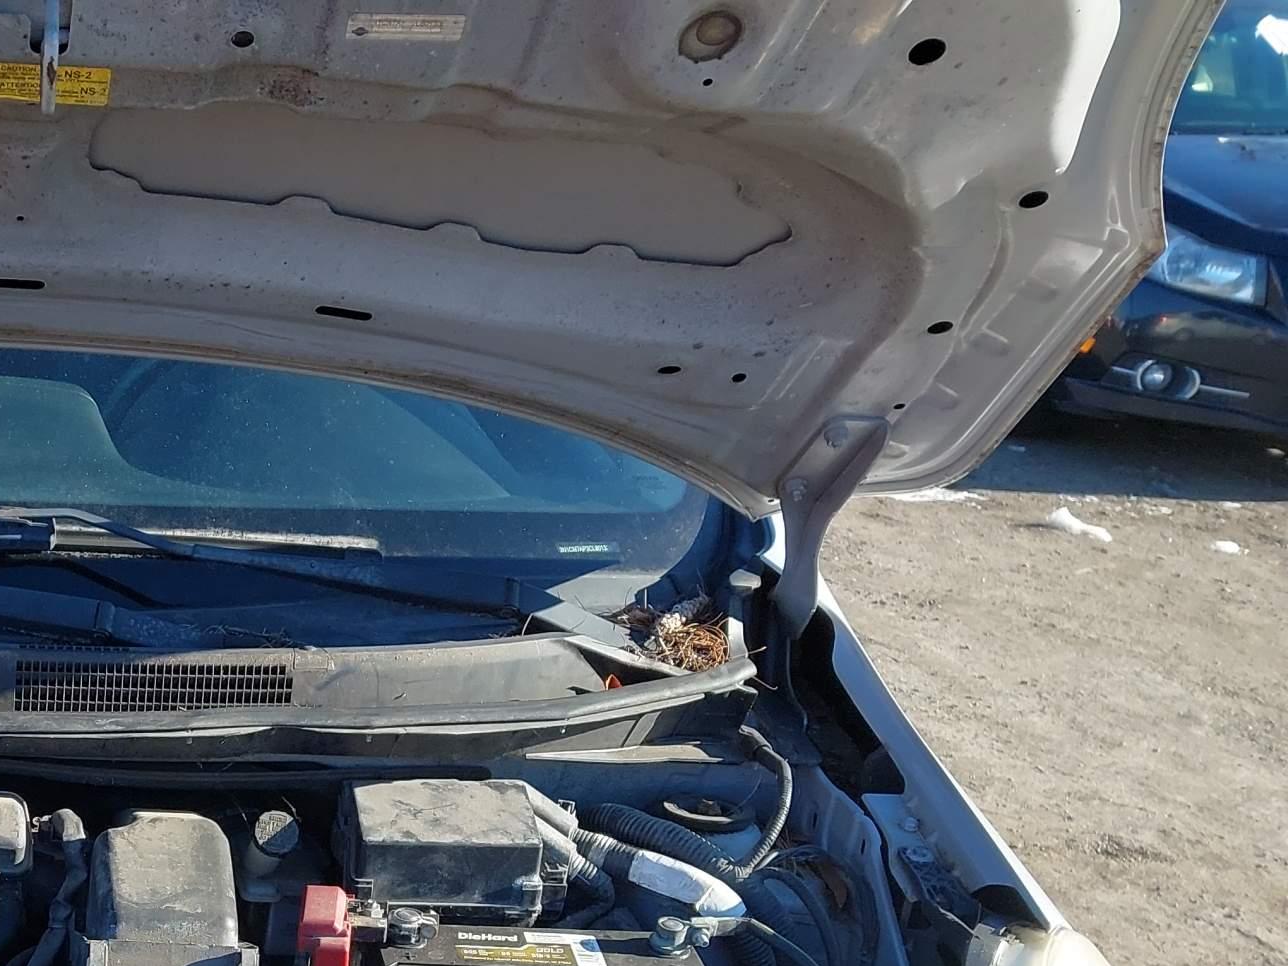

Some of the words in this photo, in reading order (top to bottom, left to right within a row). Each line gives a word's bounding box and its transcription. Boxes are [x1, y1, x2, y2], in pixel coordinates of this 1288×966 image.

[0, 64, 37, 72] CAUTION
[64, 70, 92, 79] NS-2
[80, 87, 107, 96] NS-2
[457, 931, 518, 942] DieHard
